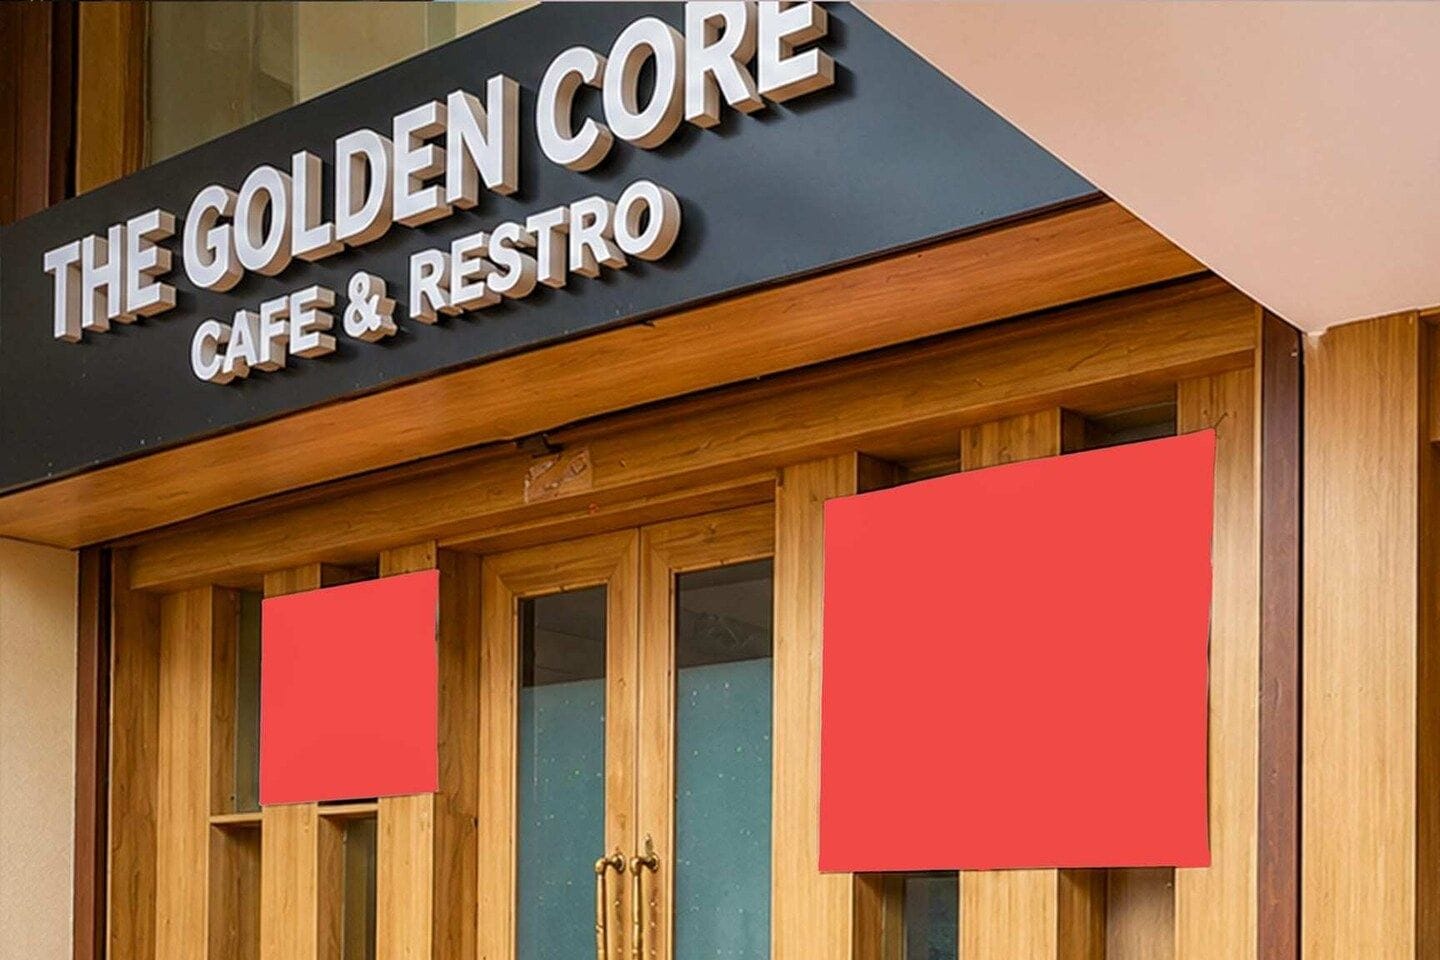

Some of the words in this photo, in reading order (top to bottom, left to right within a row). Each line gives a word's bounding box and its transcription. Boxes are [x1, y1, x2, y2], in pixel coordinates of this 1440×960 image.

[44, 208, 176, 342] THE
[183, 74, 520, 293] GOLDEN
[536, 0, 835, 171] CORE
[191, 285, 336, 384] CAFE
[344, 271, 397, 342] &
[409, 179, 682, 325] RESTRO
